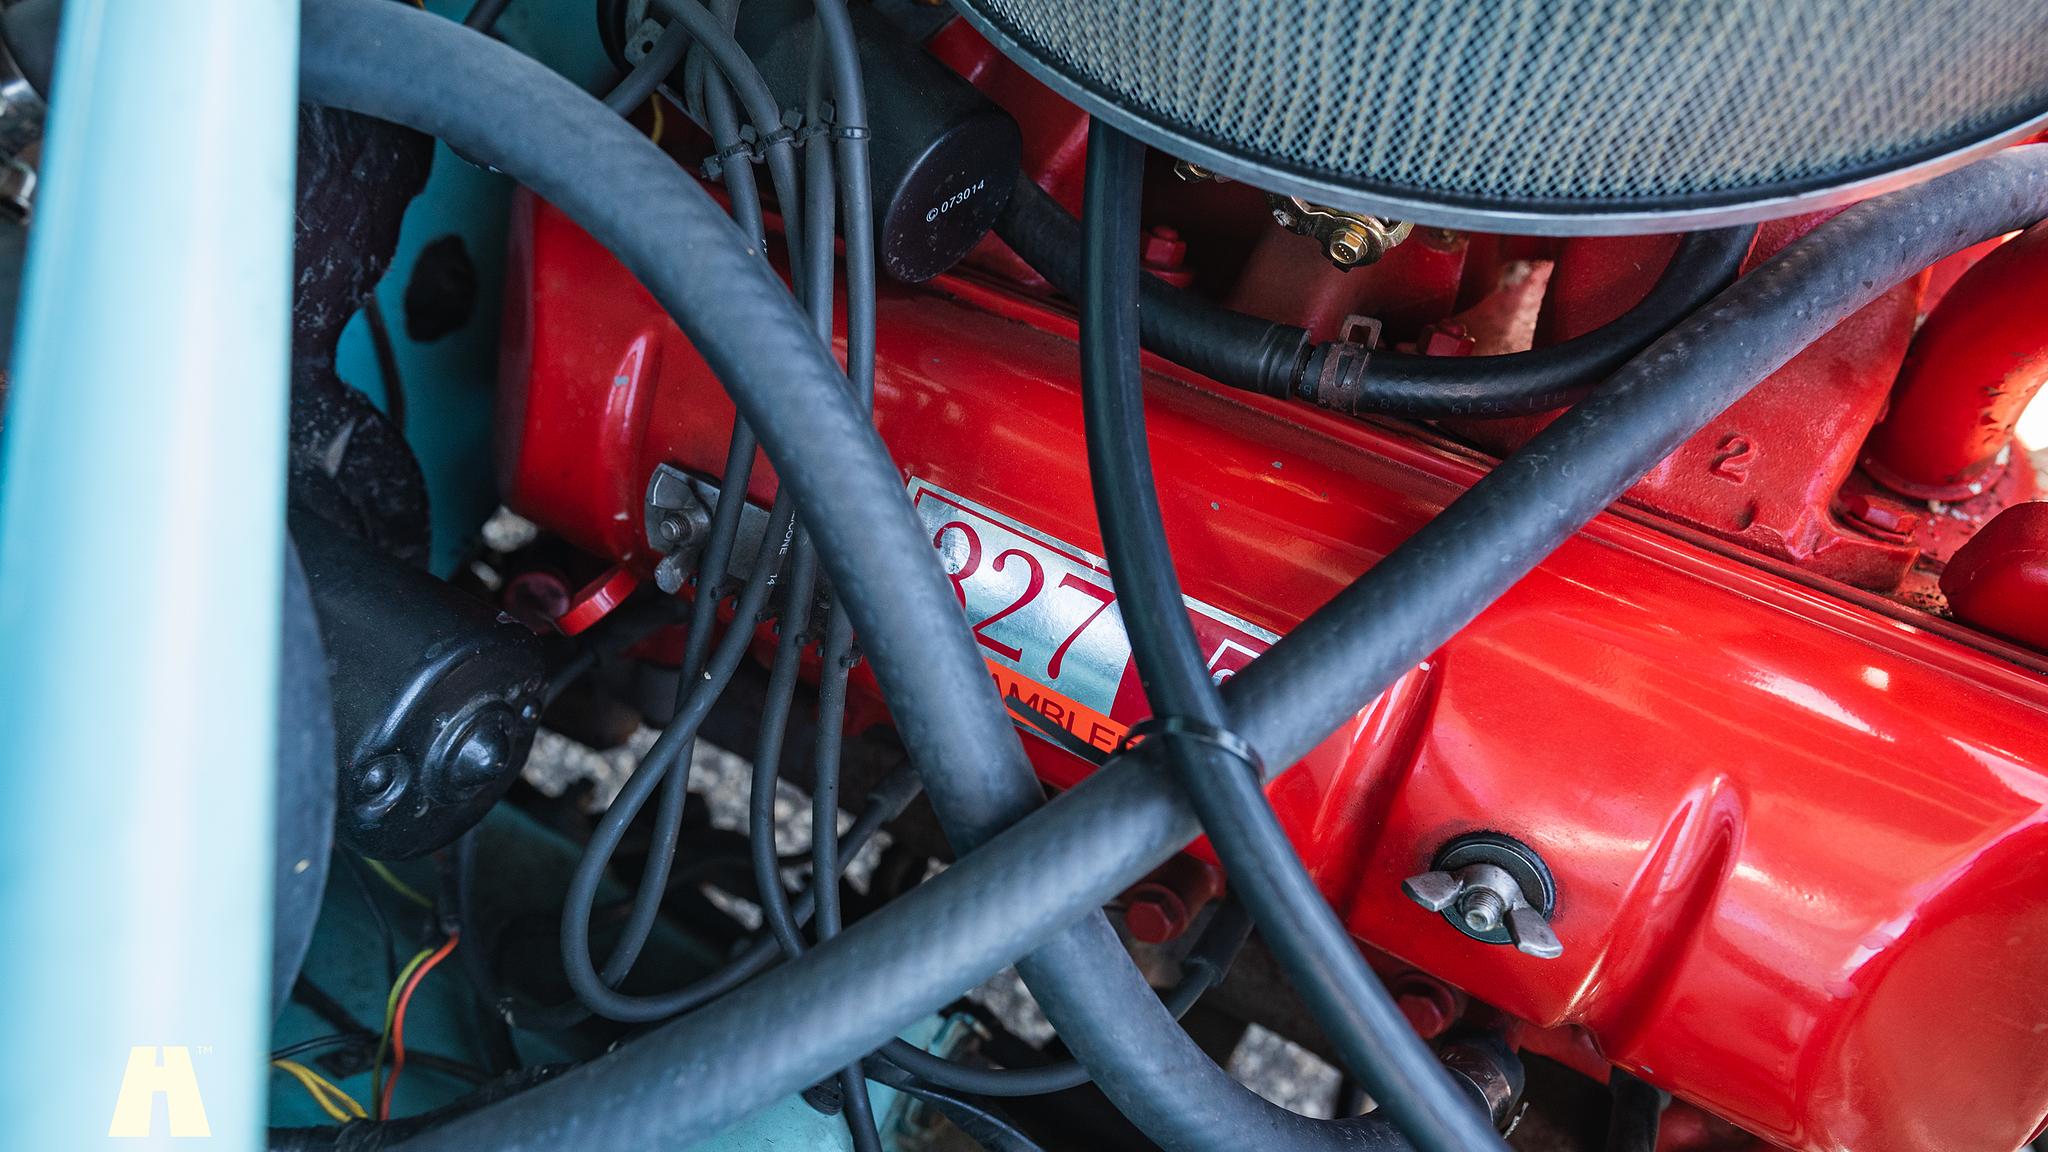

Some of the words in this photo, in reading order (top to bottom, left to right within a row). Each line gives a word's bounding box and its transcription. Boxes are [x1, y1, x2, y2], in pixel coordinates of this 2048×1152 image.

[941, 179, 985, 213] 073014
[1709, 432, 1757, 486] 2
[932, 521, 1117, 680] 327
